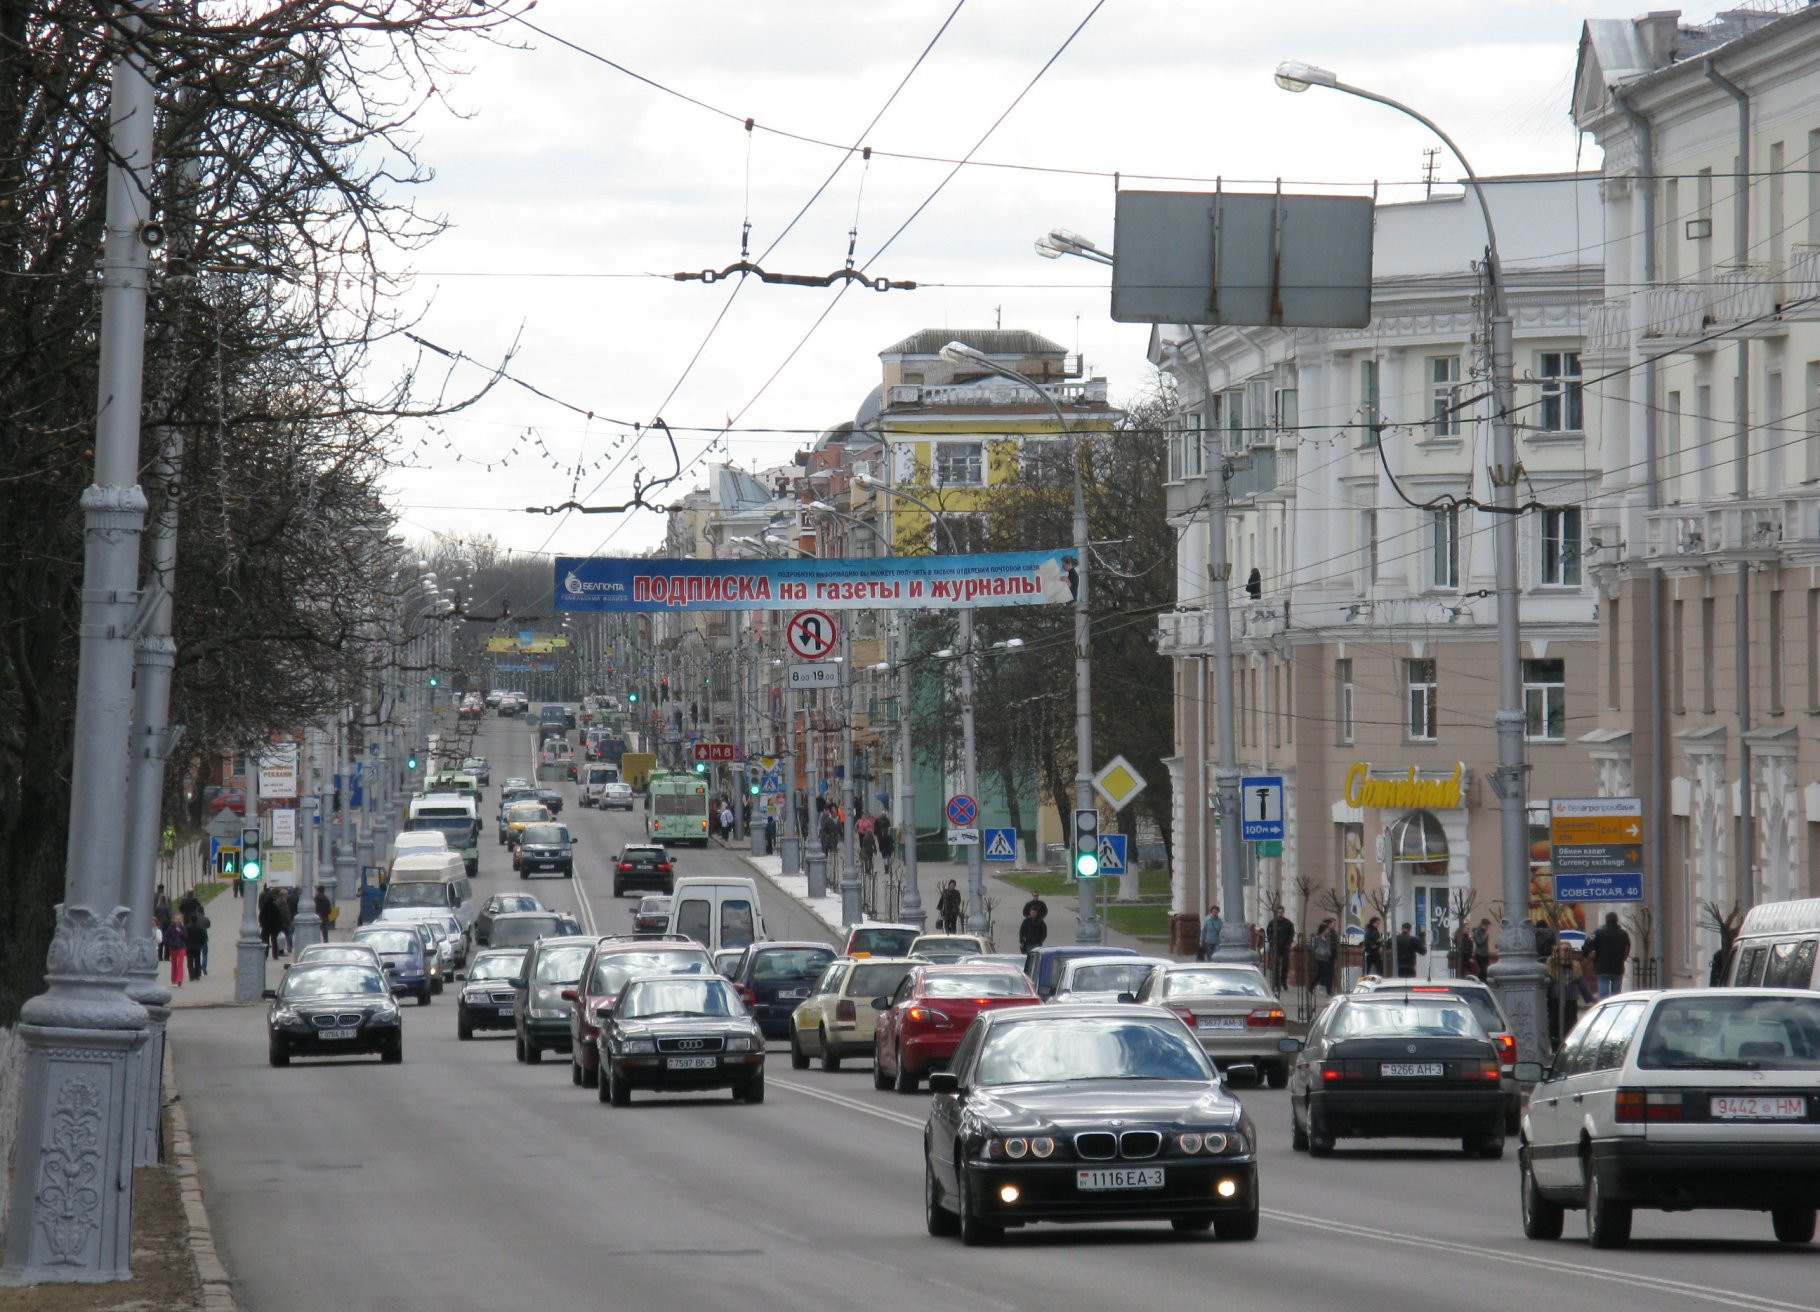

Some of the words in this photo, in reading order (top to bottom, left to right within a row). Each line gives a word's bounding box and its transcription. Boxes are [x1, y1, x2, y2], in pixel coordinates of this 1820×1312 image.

[582, 582, 625, 592] БЕЛПОЧТА
[634, 575, 772, 606] ПОДПИСКА
[779, 580, 807, 601] на
[816, 580, 900, 601] газеты
[908, 579, 923, 599] и
[930, 575, 1042, 603] журналы
[1558, 847, 1583, 855] Обмен
[1558, 858, 1590, 867] Currency
[1591, 858, 1625, 868] exchange
[1585, 877, 1613, 886] улица
[1561, 887, 1624, 897] СОВЕТСКАЯ,
[1626, 887, 1638, 896] 40
[1718, 1098, 1758, 1114] 9442
[1776, 1098, 1803, 1114] HM
[1092, 1172, 1125, 1186] 1116
